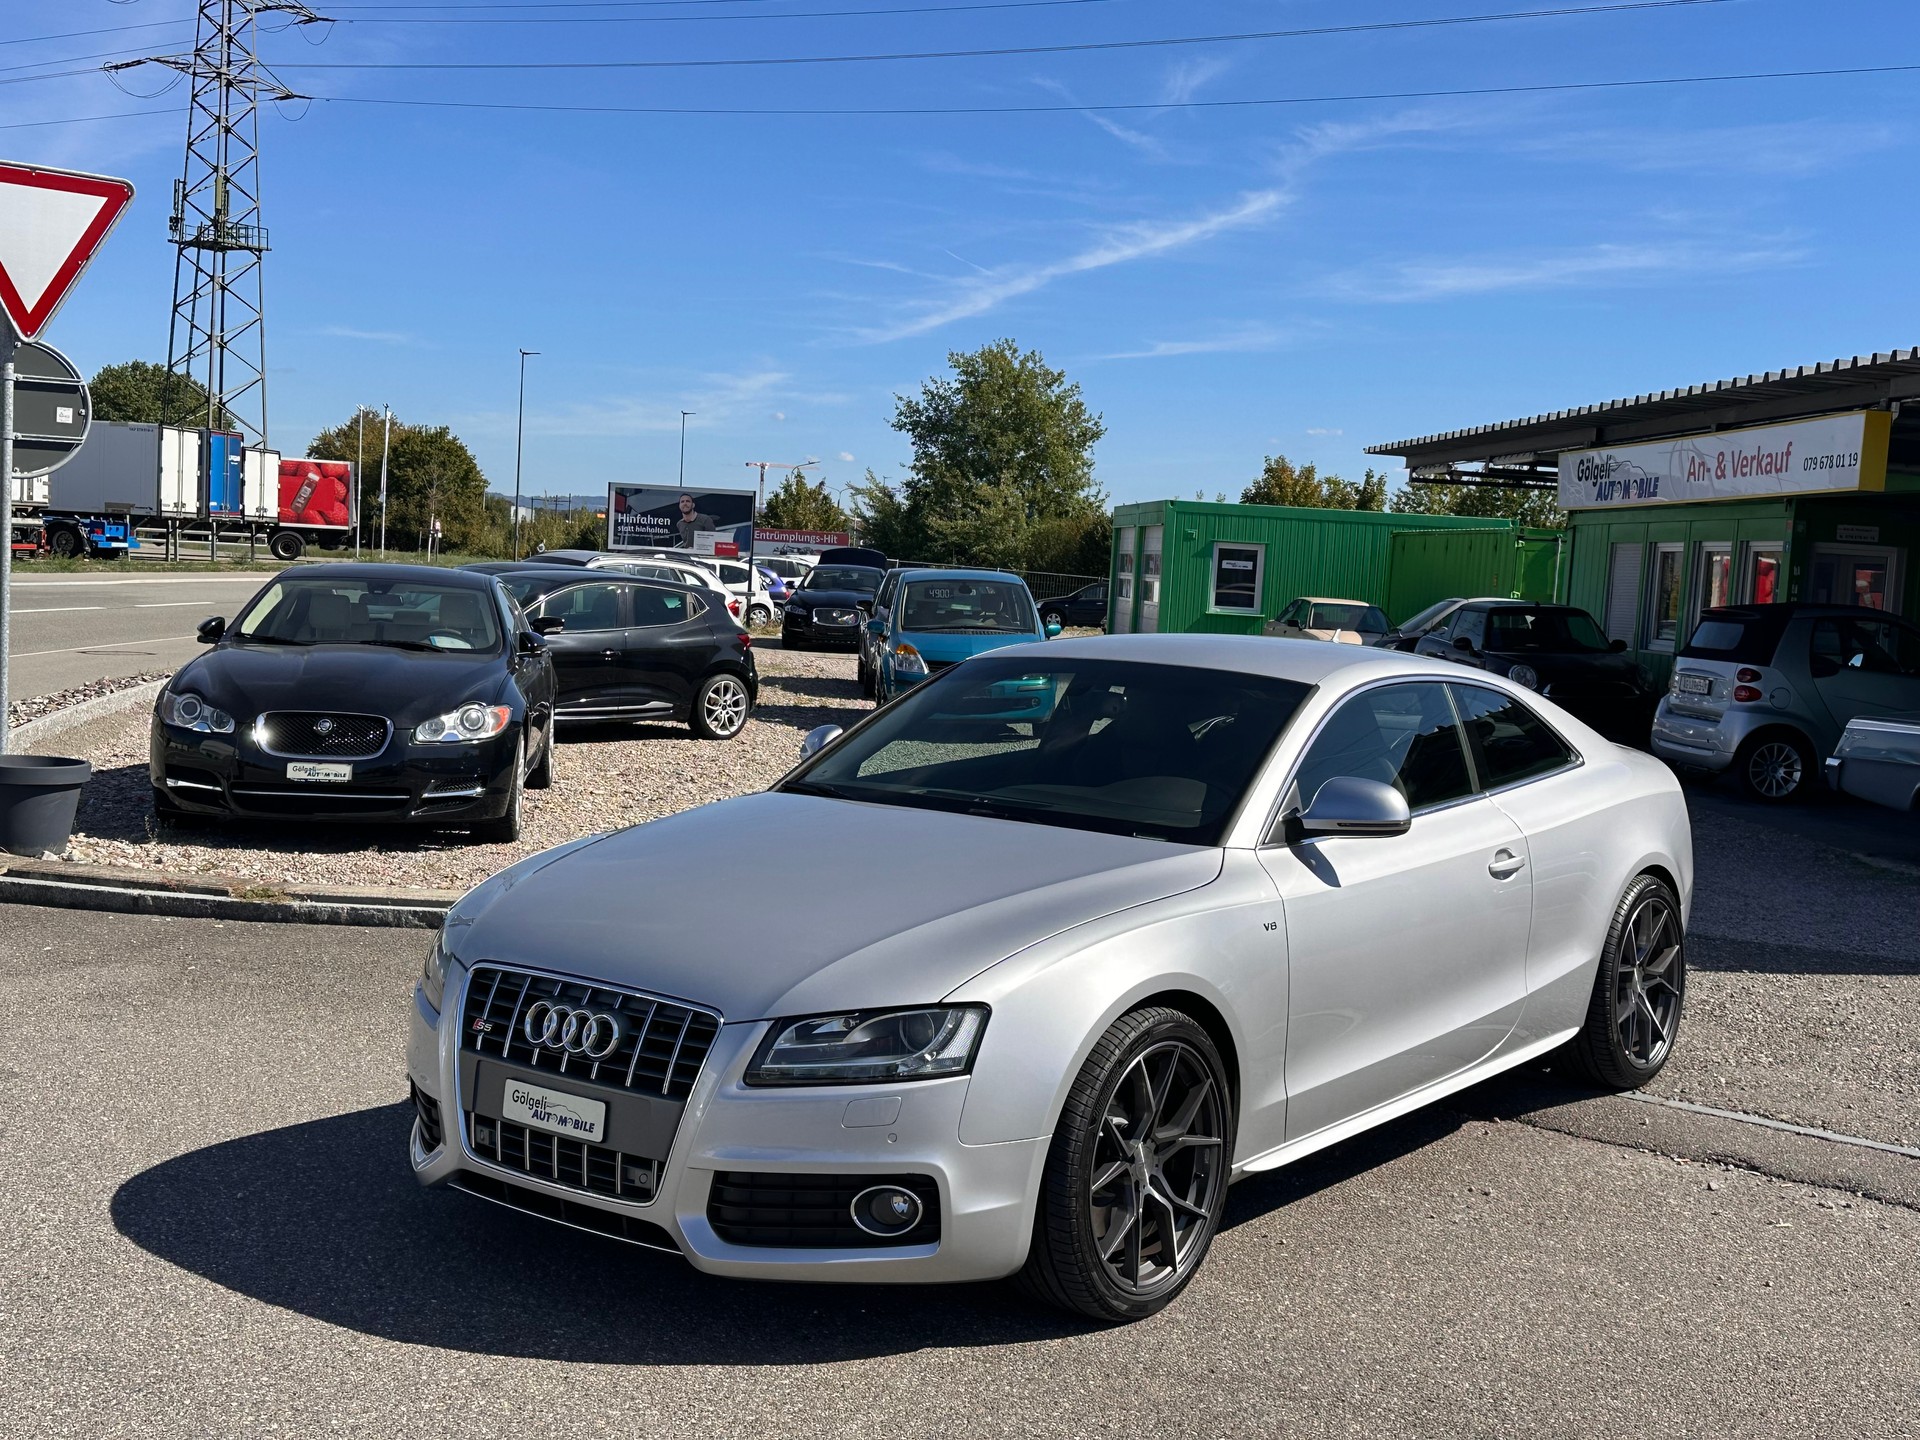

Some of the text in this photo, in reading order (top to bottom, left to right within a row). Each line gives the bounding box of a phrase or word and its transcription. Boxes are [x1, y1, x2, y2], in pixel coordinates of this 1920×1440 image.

[1577, 455, 1612, 487] Gölgeli
[1686, 441, 1793, 482] An- & Verkauf
[1803, 452, 1859, 471] 079 678 01 19
[1595, 477, 1660, 501] AUTOMOBILE
[618, 513, 671, 526] Hinfahren
[754, 530, 838, 544] Entrümplungs-Hit
[1263, 921, 1277, 931] V8
[512, 1089, 548, 1111] Gölgeli
